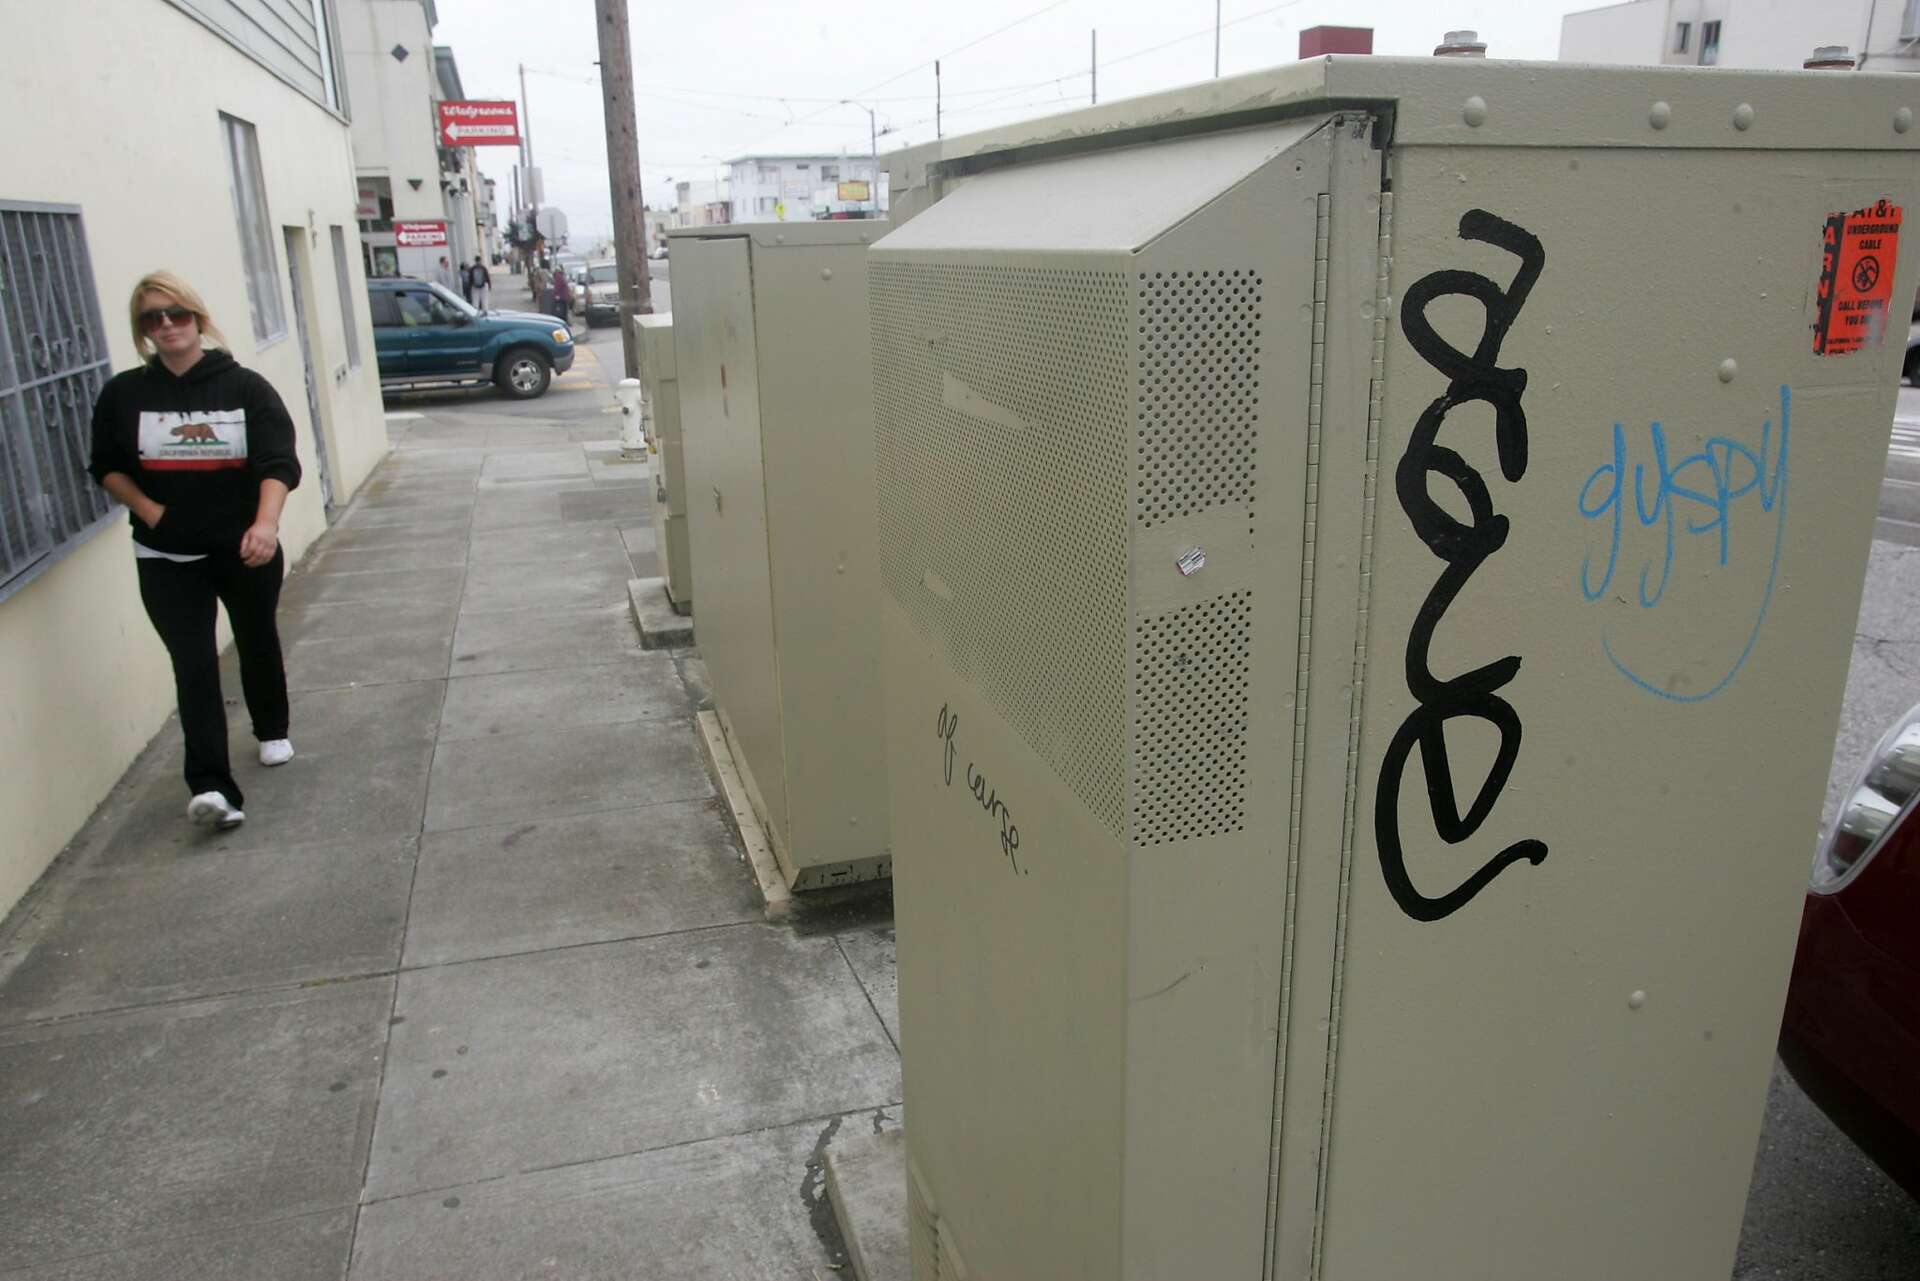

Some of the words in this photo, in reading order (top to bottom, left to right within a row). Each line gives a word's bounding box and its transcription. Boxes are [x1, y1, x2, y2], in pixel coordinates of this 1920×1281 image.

[442, 105, 513, 118] Walgreens
[457, 126, 506, 136] PARKING
[1847, 224, 1899, 234] UNDERGROUND
[406, 233, 443, 241] PARKING
[1859, 240, 1882, 249] CABLE
[1838, 301, 1856, 311] CALL
